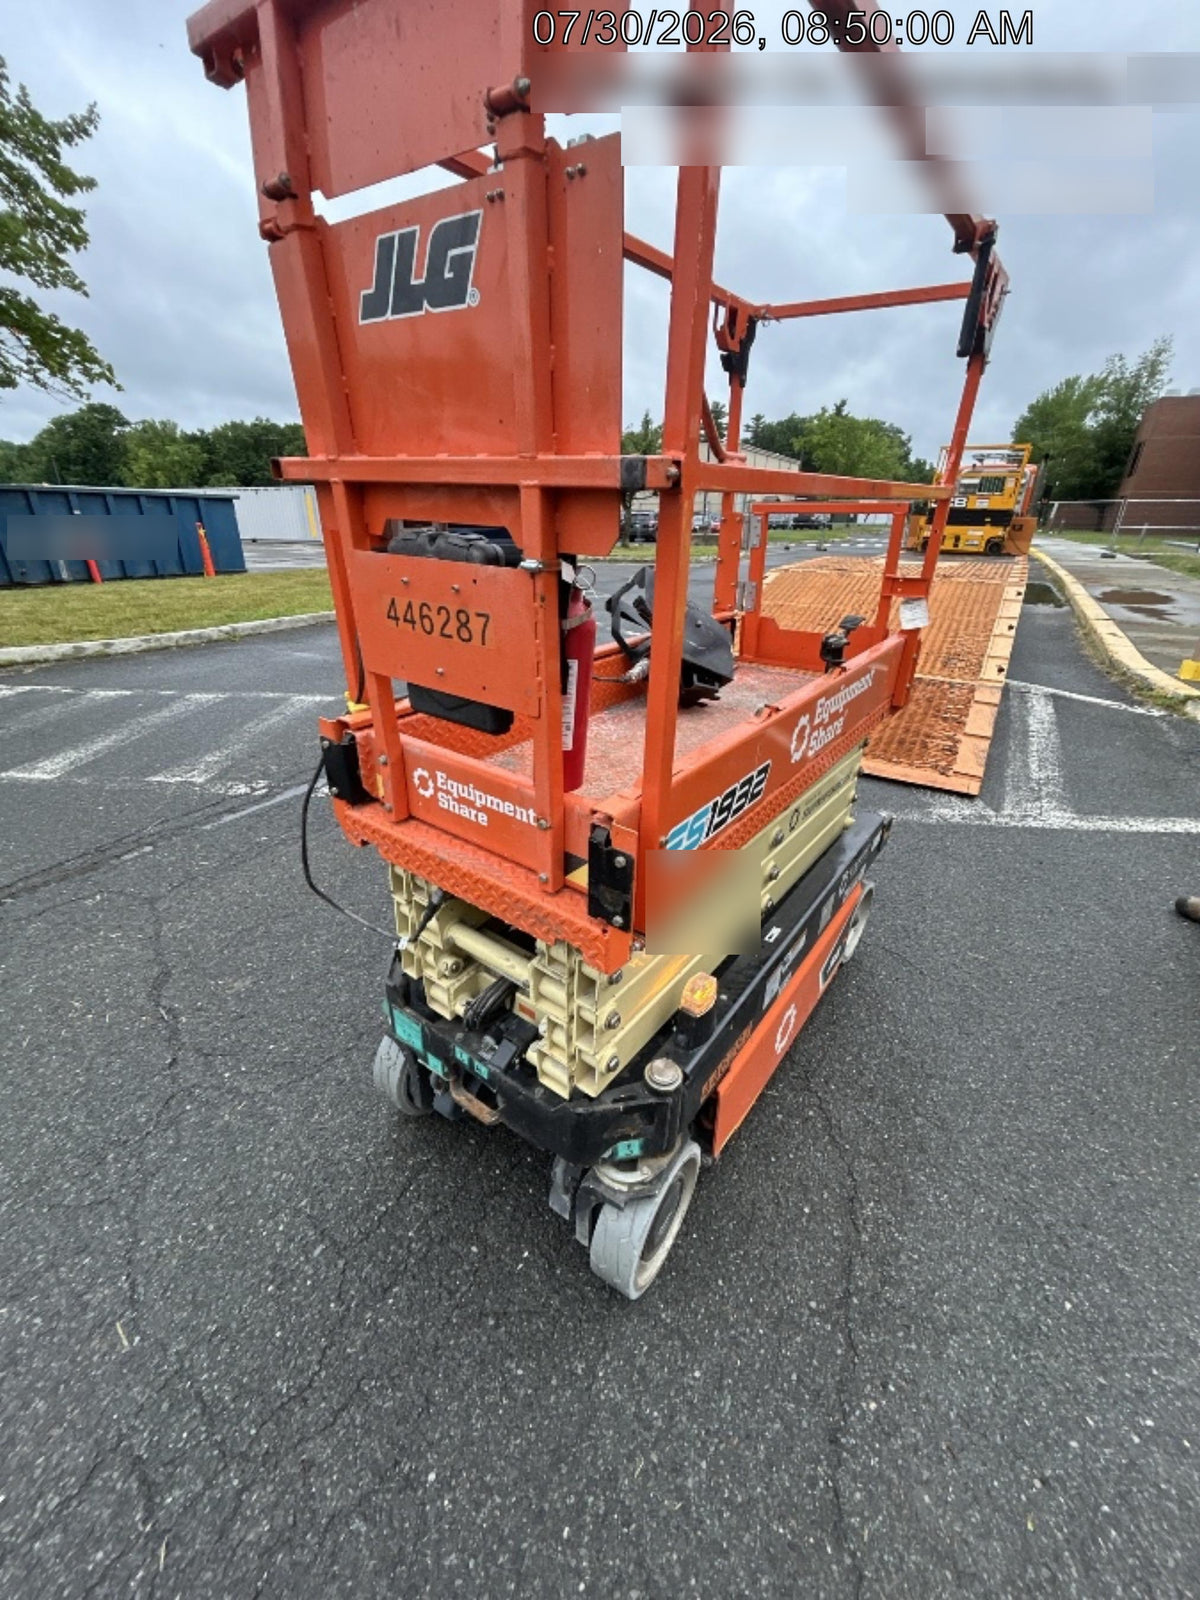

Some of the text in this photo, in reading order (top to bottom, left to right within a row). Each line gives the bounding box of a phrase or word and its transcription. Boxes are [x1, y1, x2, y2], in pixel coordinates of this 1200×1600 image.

[386, 597, 490, 646] 446287
[435, 770, 539, 827] Equipment
[437, 791, 488, 827] Share
[665, 759, 772, 850] ES1932
